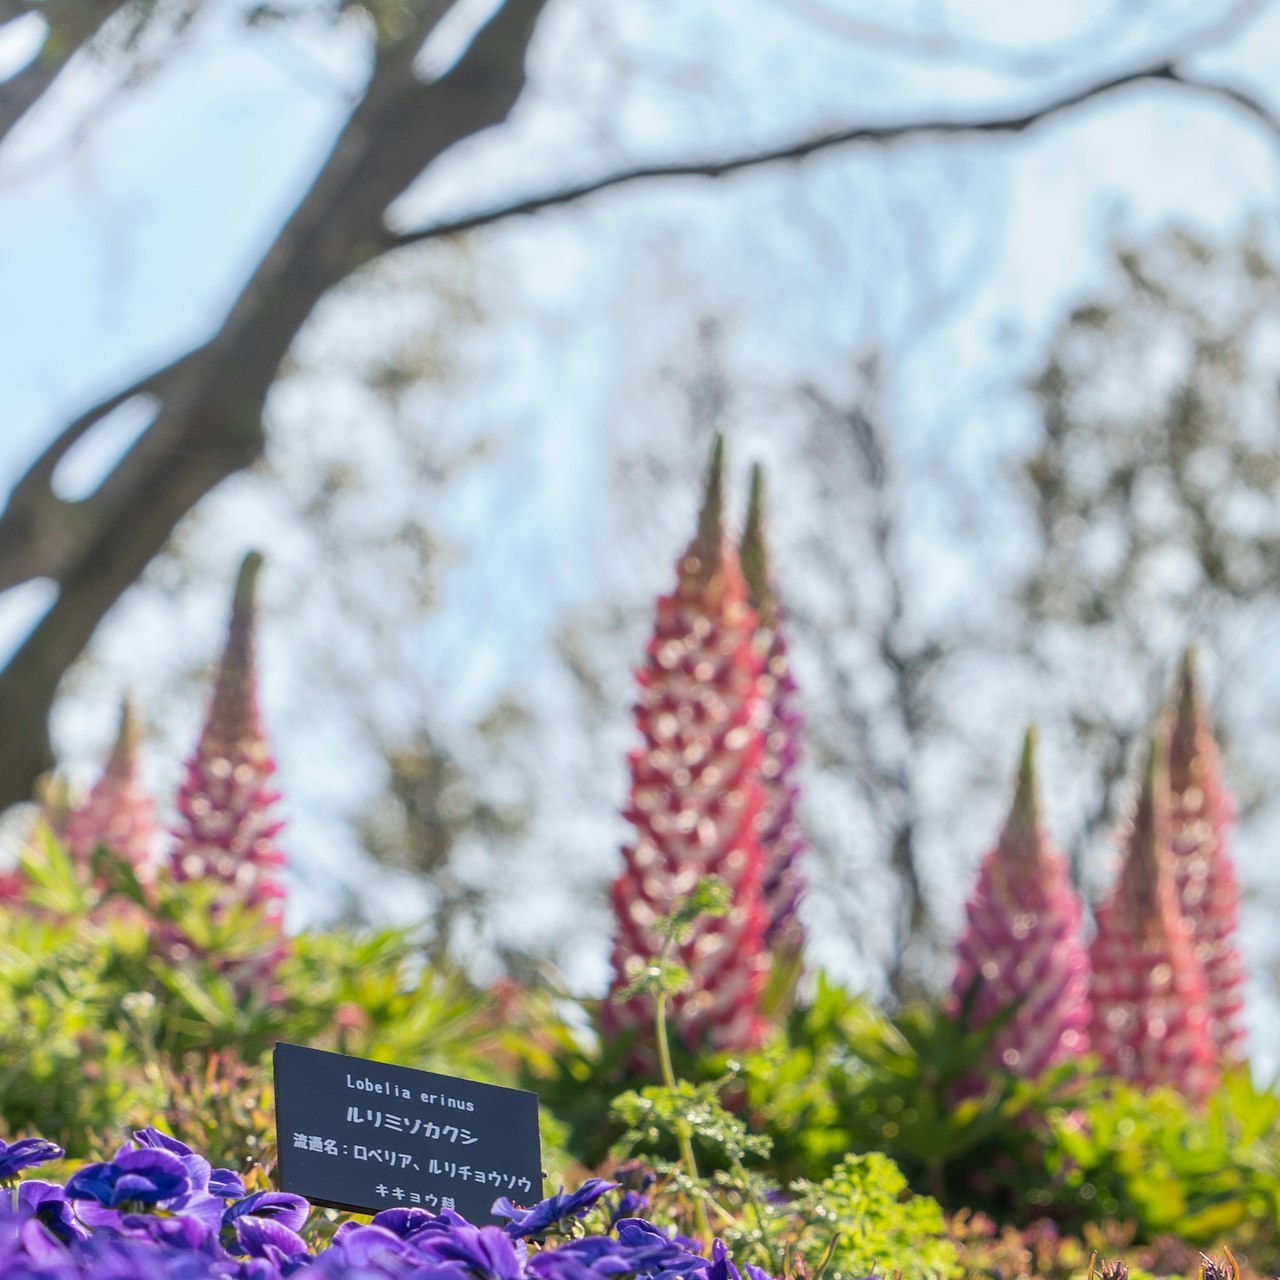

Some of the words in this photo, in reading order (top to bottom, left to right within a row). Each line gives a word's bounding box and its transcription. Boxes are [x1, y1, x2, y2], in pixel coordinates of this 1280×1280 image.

[346, 1073, 411, 1100] Lobelia
[420, 1091, 475, 1112] erinus
[346, 1106, 479, 1145] ルリミゾカクシ
[375, 1183, 456, 1210] キキョウ科
